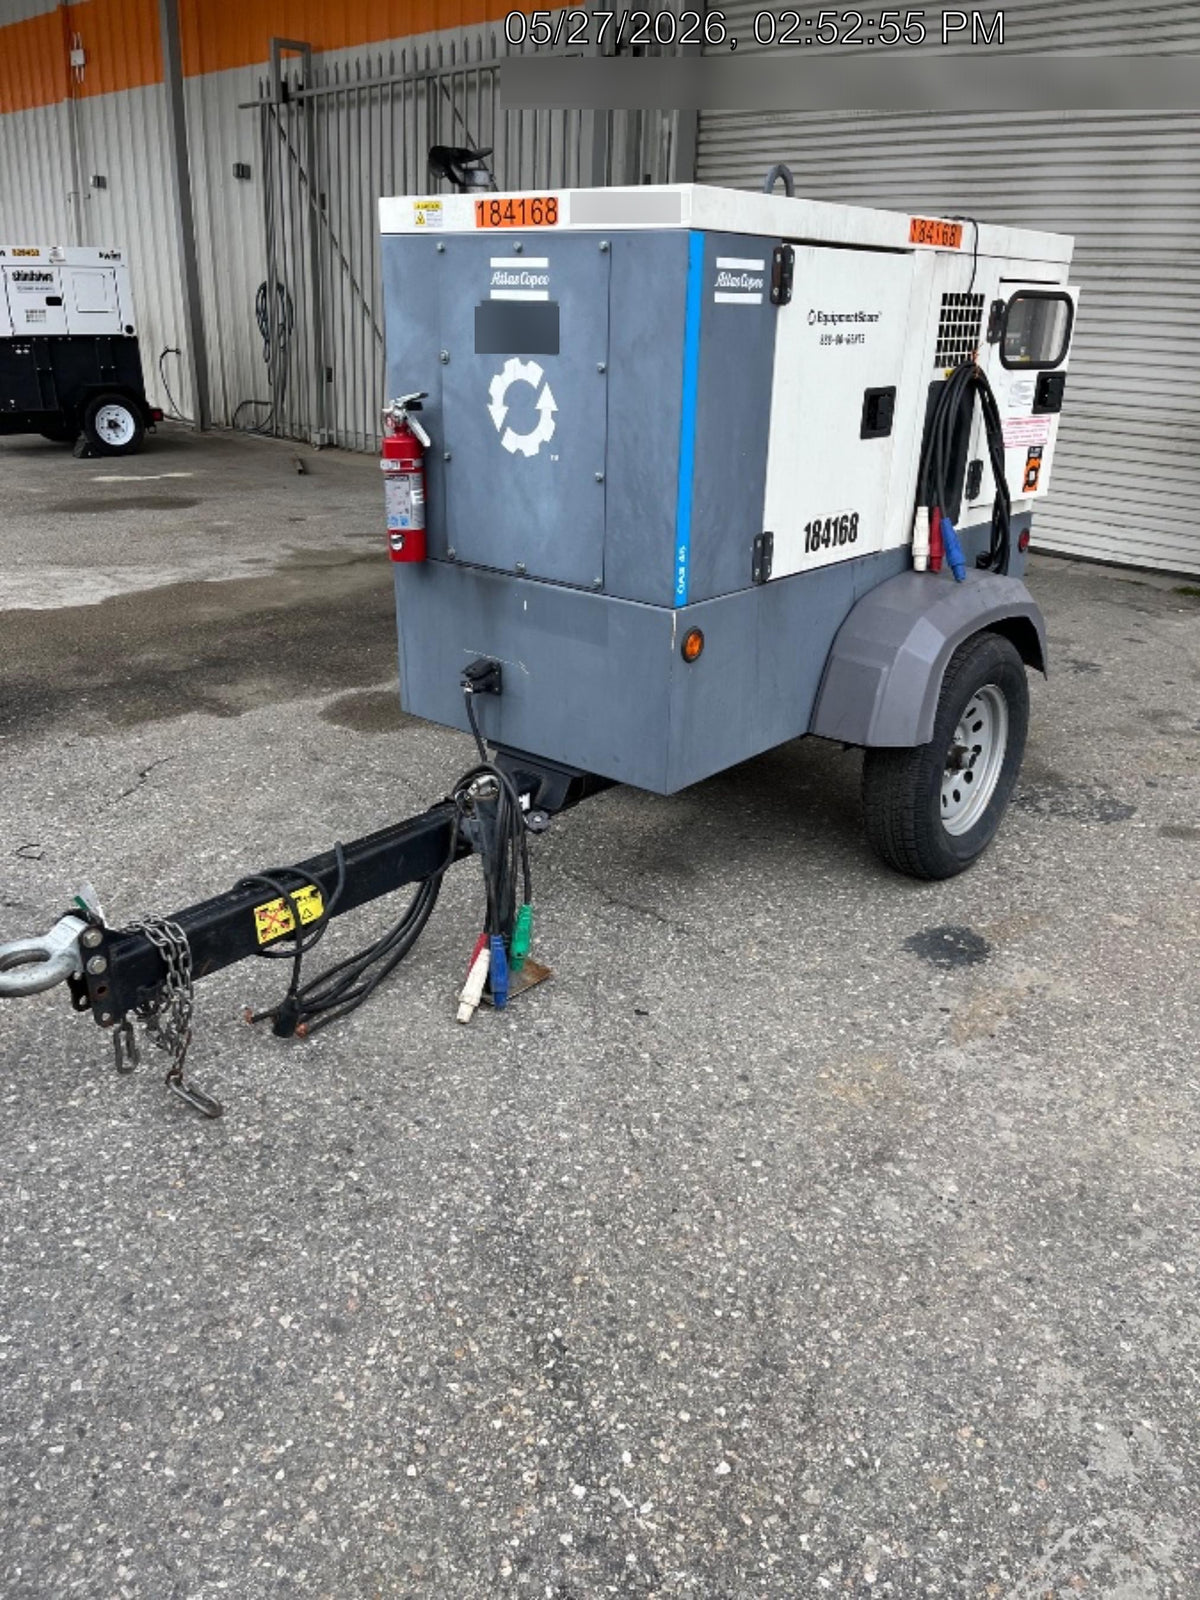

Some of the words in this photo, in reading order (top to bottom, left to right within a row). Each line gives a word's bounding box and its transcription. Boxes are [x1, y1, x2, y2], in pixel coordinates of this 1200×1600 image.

[478, 197, 557, 226] 184168
[911, 219, 957, 247] 184168
[490, 271, 519, 286] Atlas
[520, 271, 550, 289] Copco
[803, 511, 859, 553] 184168
